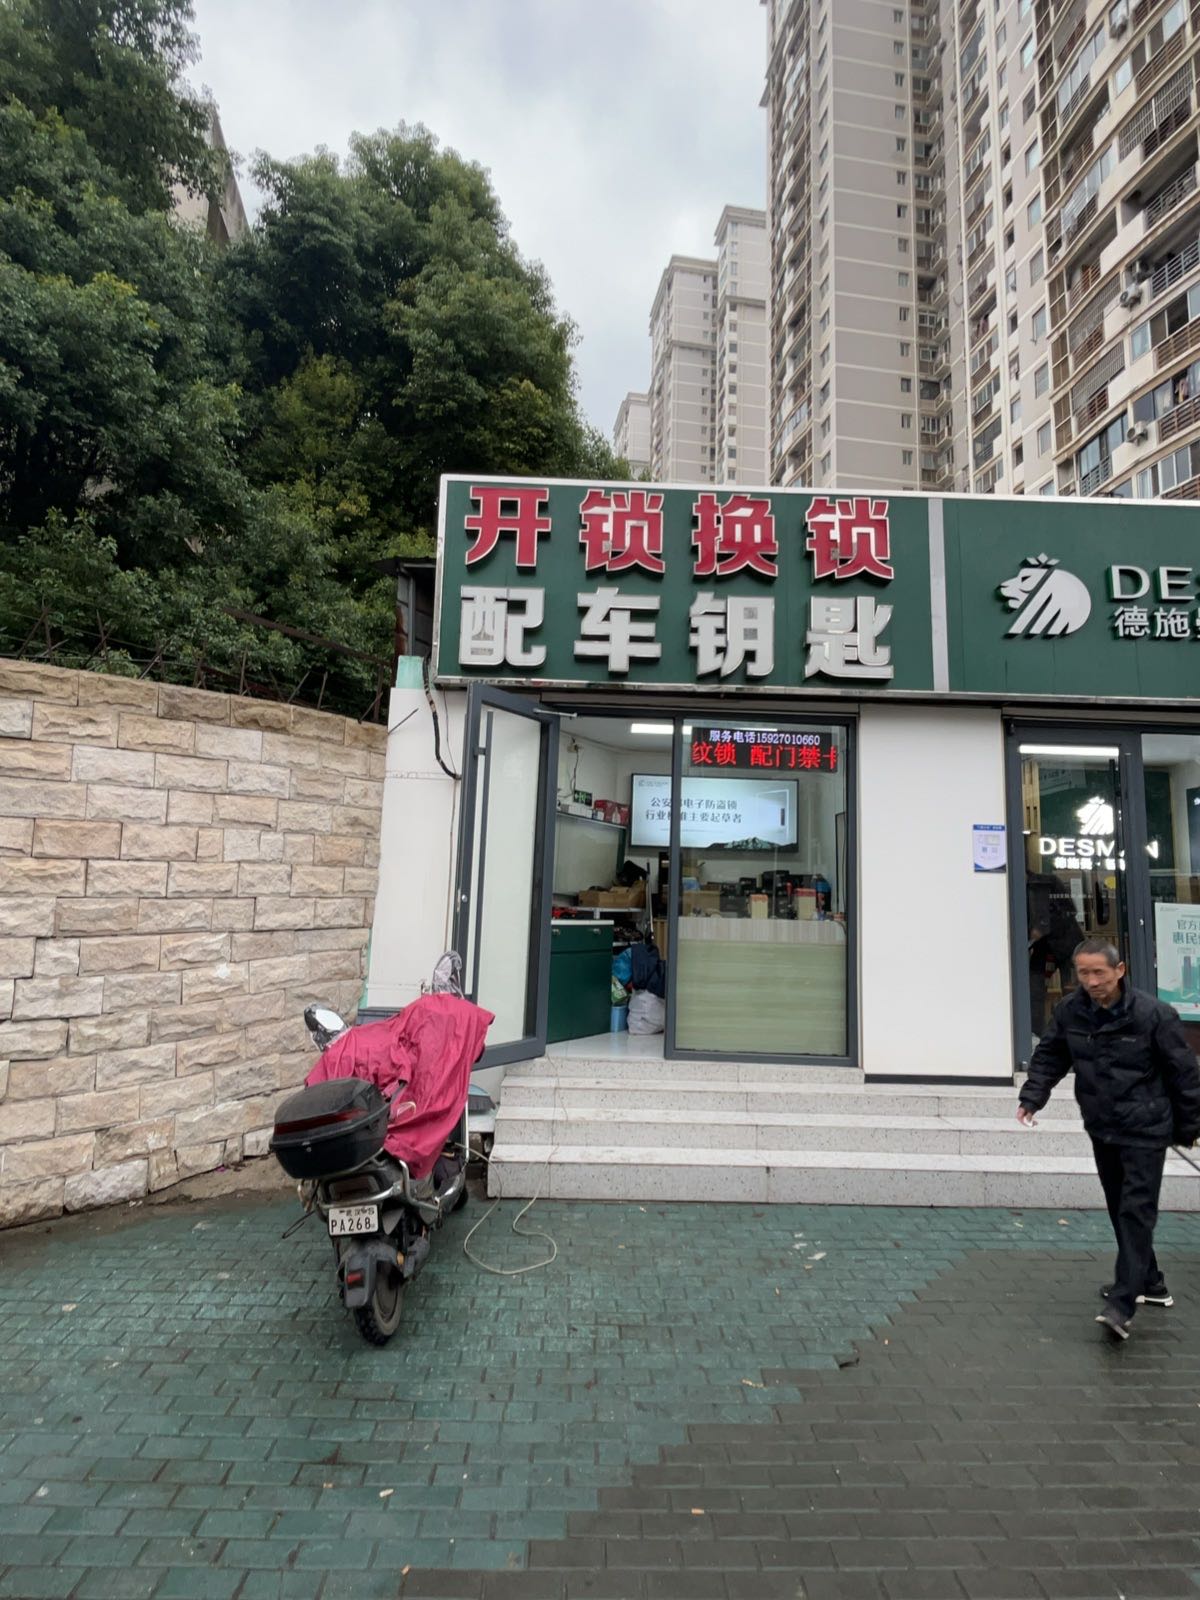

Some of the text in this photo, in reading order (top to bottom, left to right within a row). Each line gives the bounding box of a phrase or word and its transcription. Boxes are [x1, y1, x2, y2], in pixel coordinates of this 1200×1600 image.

[464, 486, 895, 580] 开锁换锁
[1114, 606, 1200, 638] 德施
[458, 585, 894, 680] 配车钥匙
[709, 729, 821, 746] 服务电话15927010660
[690, 741, 737, 765] 纹锁
[651, 797, 737, 810] 公安电子防盗锁
[1177, 919, 1200, 931] 官方
[1173, 931, 1200, 944] 惠民
